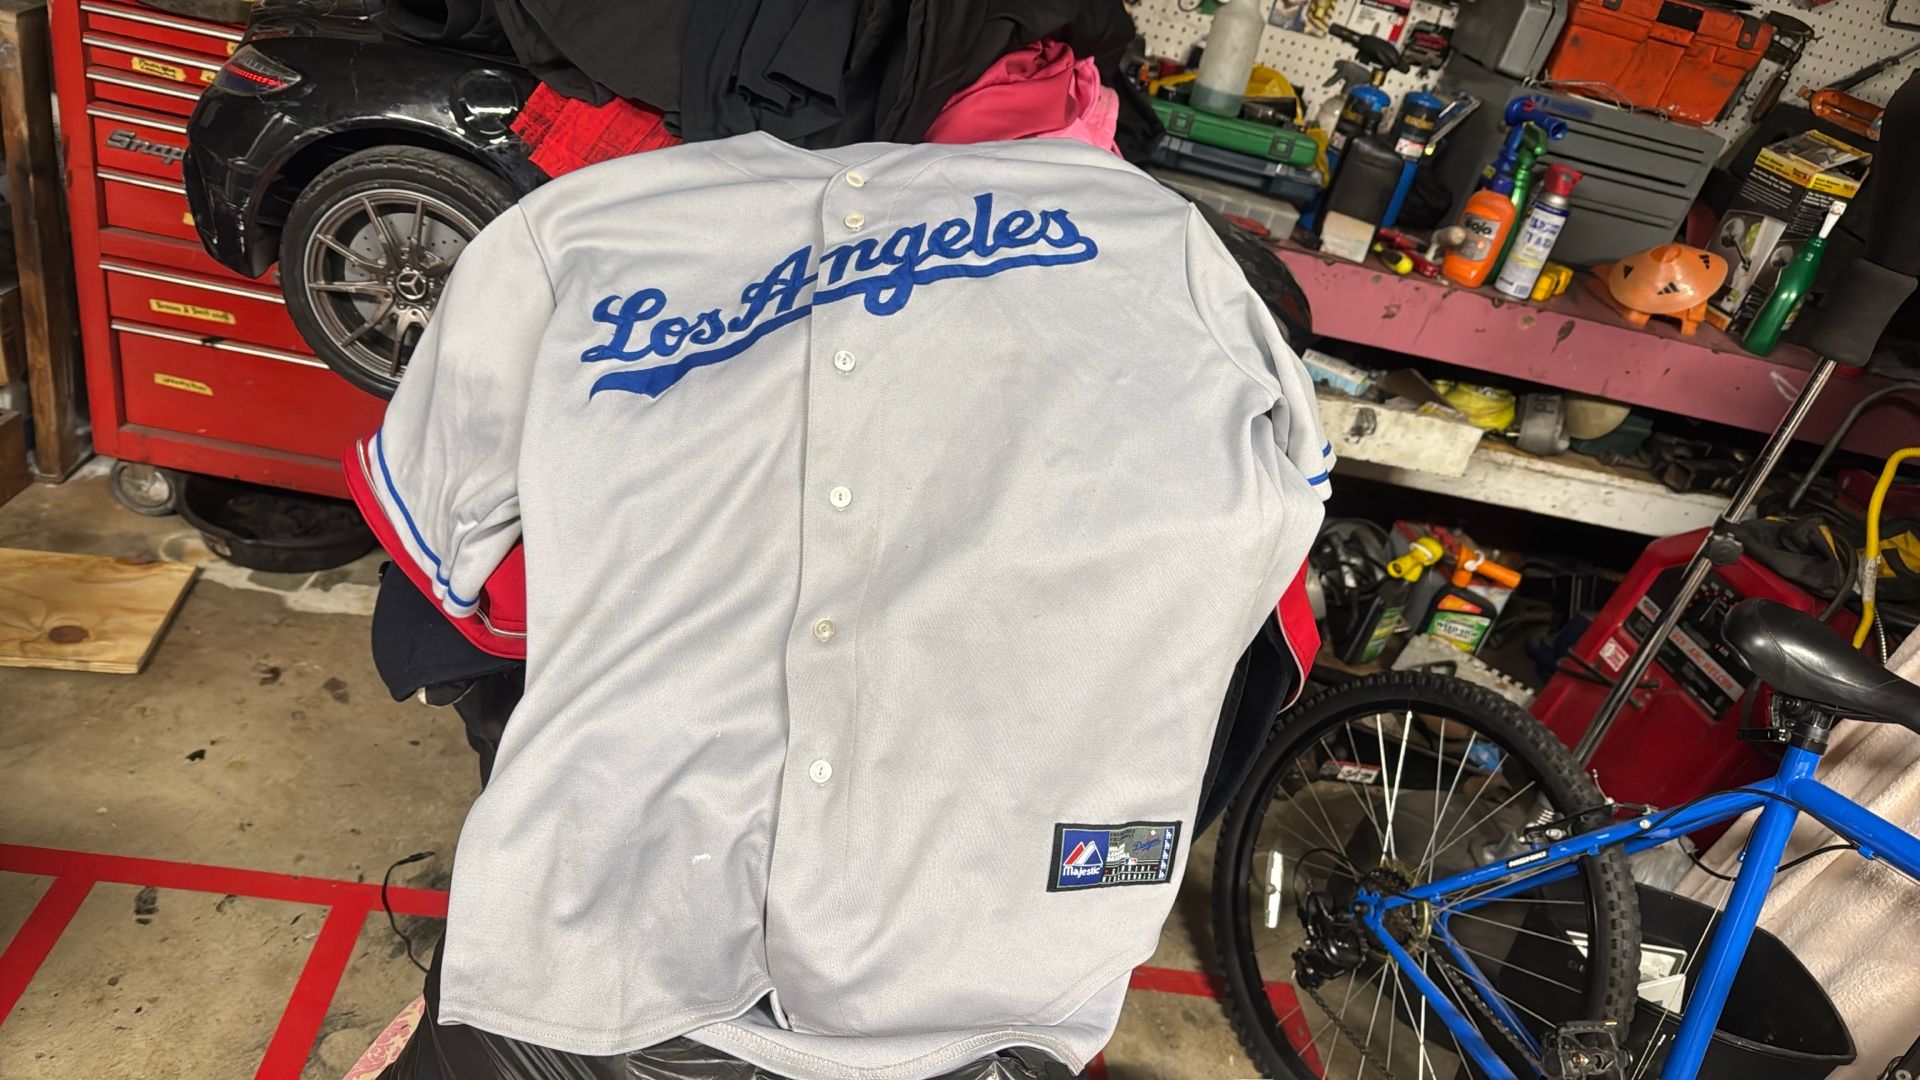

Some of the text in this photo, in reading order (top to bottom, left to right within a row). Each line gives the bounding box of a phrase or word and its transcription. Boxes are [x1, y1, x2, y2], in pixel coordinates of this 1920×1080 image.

[581, 193, 1090, 362] Los Angeles
[1063, 865, 1101, 879] Majestic
